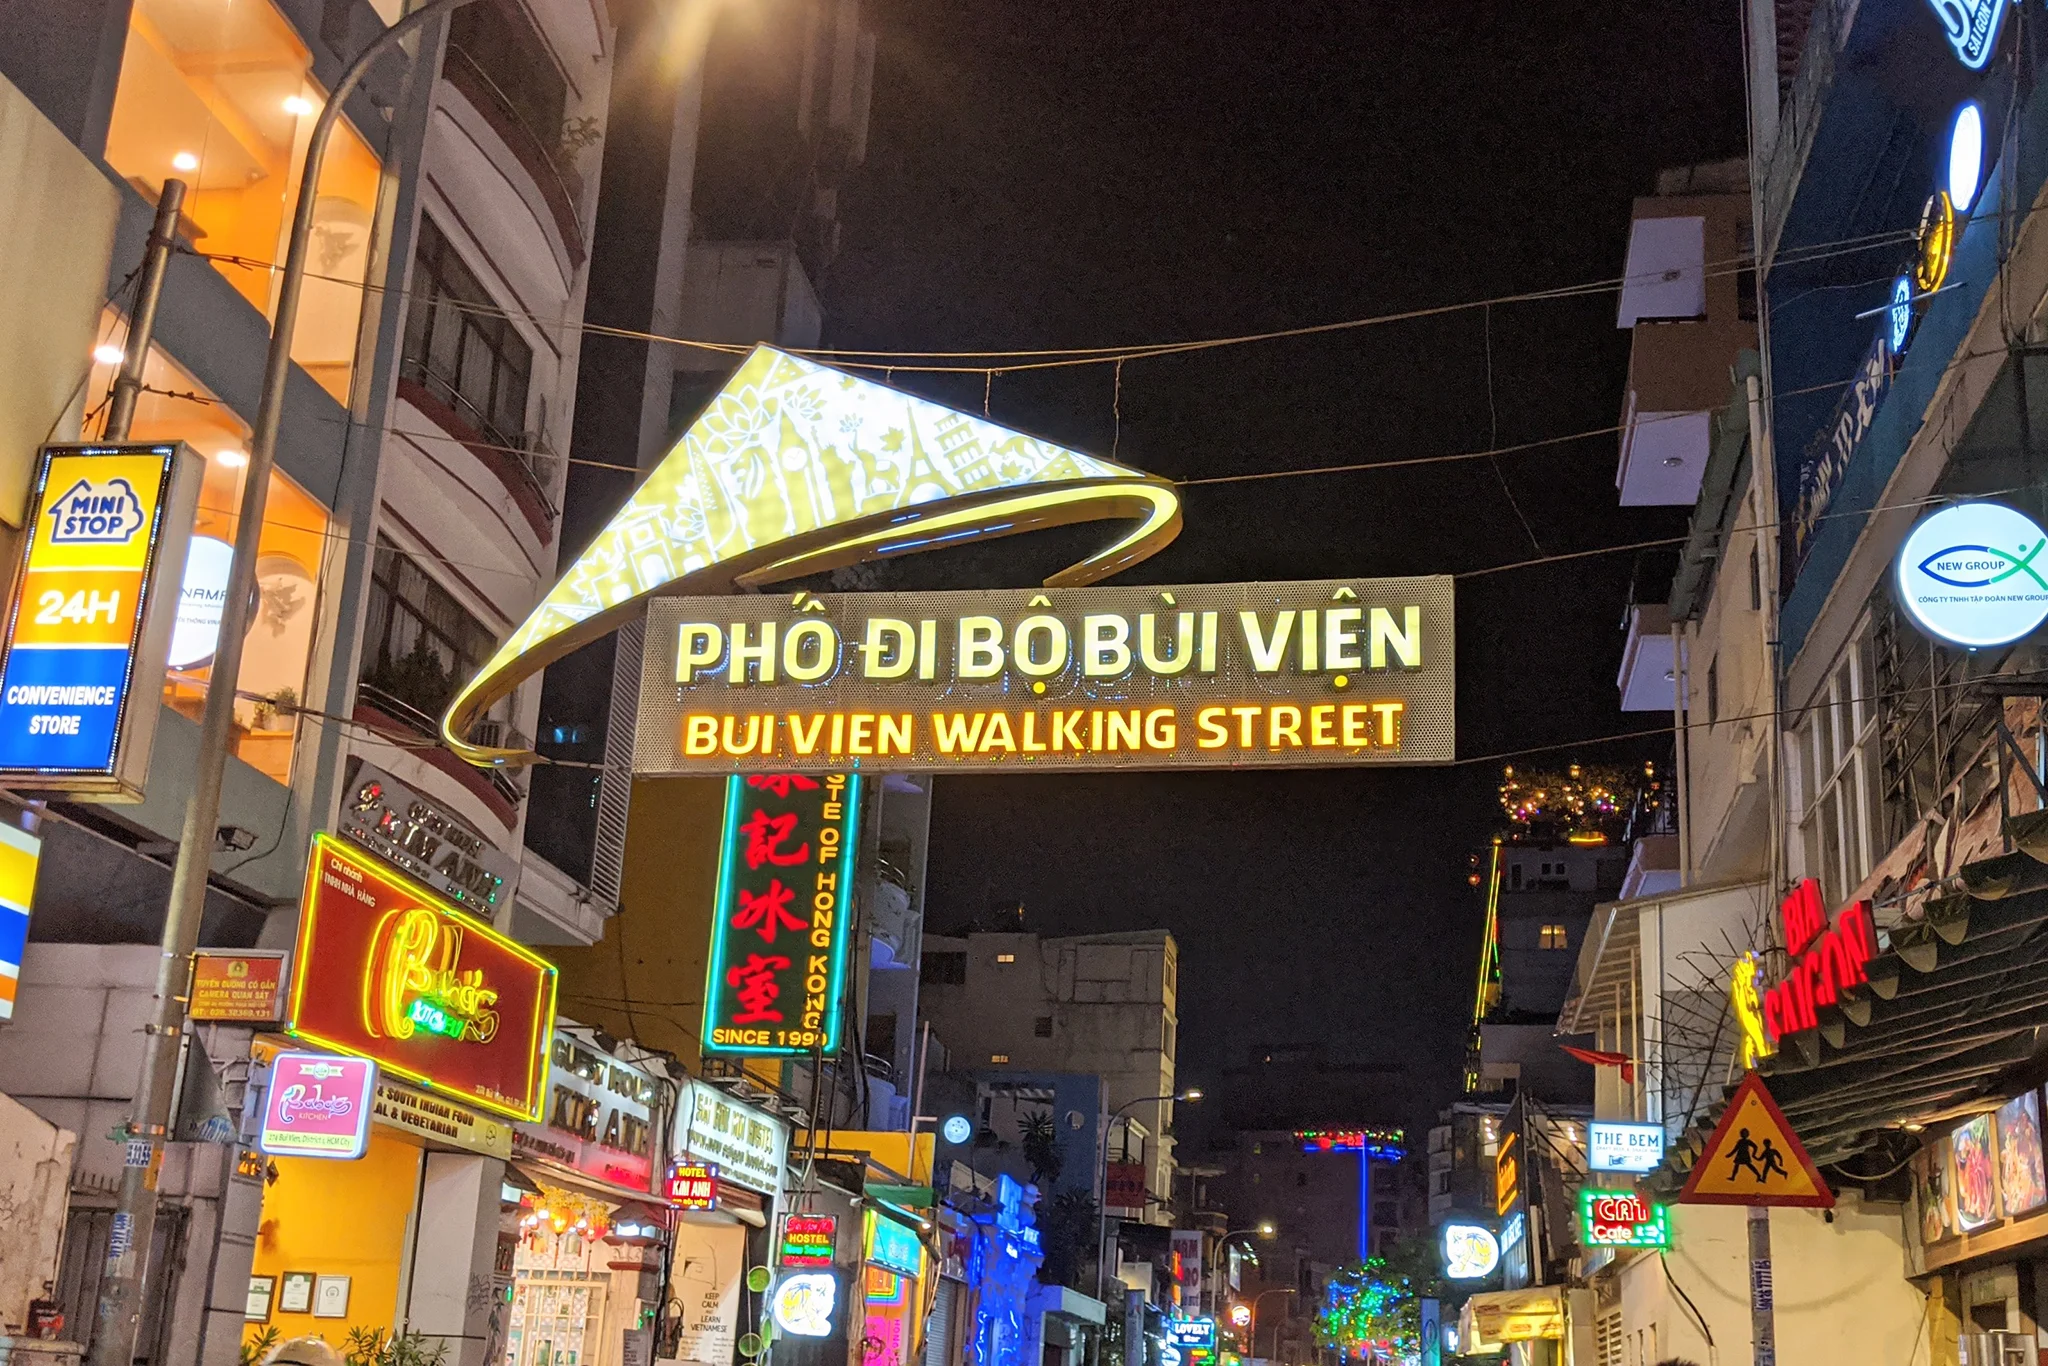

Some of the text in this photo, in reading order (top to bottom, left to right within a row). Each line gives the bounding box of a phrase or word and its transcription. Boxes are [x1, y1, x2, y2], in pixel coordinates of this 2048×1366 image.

[70, 496, 125, 514] MINI
[64, 516, 124, 535] STOP
[1937, 561, 2005, 571] NEW GROUP
[34, 589, 120, 624] 24H
[676, 587, 1421, 694] PHỐ ĐI BỘ BÙI VIỆN
[7, 685, 116, 706] CONVENIENCE
[29, 715, 81, 735] STORE
[685, 703, 1404, 756] BUI VIEN WALKING STREET
[819, 827, 840, 865] OF
[810, 872, 837, 947] HONG
[1781, 877, 1821, 957] BIA
[199, 990, 230, 999] CAMERA
[803, 955, 828, 1029] KONG
[713, 1029, 771, 1046] SINCE
[376, 1085, 475, 1127] & SOUTH INDIAN FOOD
[299, 1113, 329, 1121] KITCHEN
[390, 1107, 398, 1120] &
[401, 1109, 459, 1139] VEGETARIAN
[1594, 1132, 1659, 1147] THE BEM
[679, 1167, 707, 1178] HOTEL
[672, 1180, 711, 1198] KIM ANH
[789, 1233, 829, 1244] HOSTEL
[1594, 1224, 1633, 1241] Cafe
[702, 1300, 719, 1309] CALM
[704, 1292, 720, 1301] KEEP
[691, 1323, 728, 1334] VIETNAMESE
[701, 1315, 721, 1324] LEARN
[1174, 1323, 1211, 1335] LOVELY
